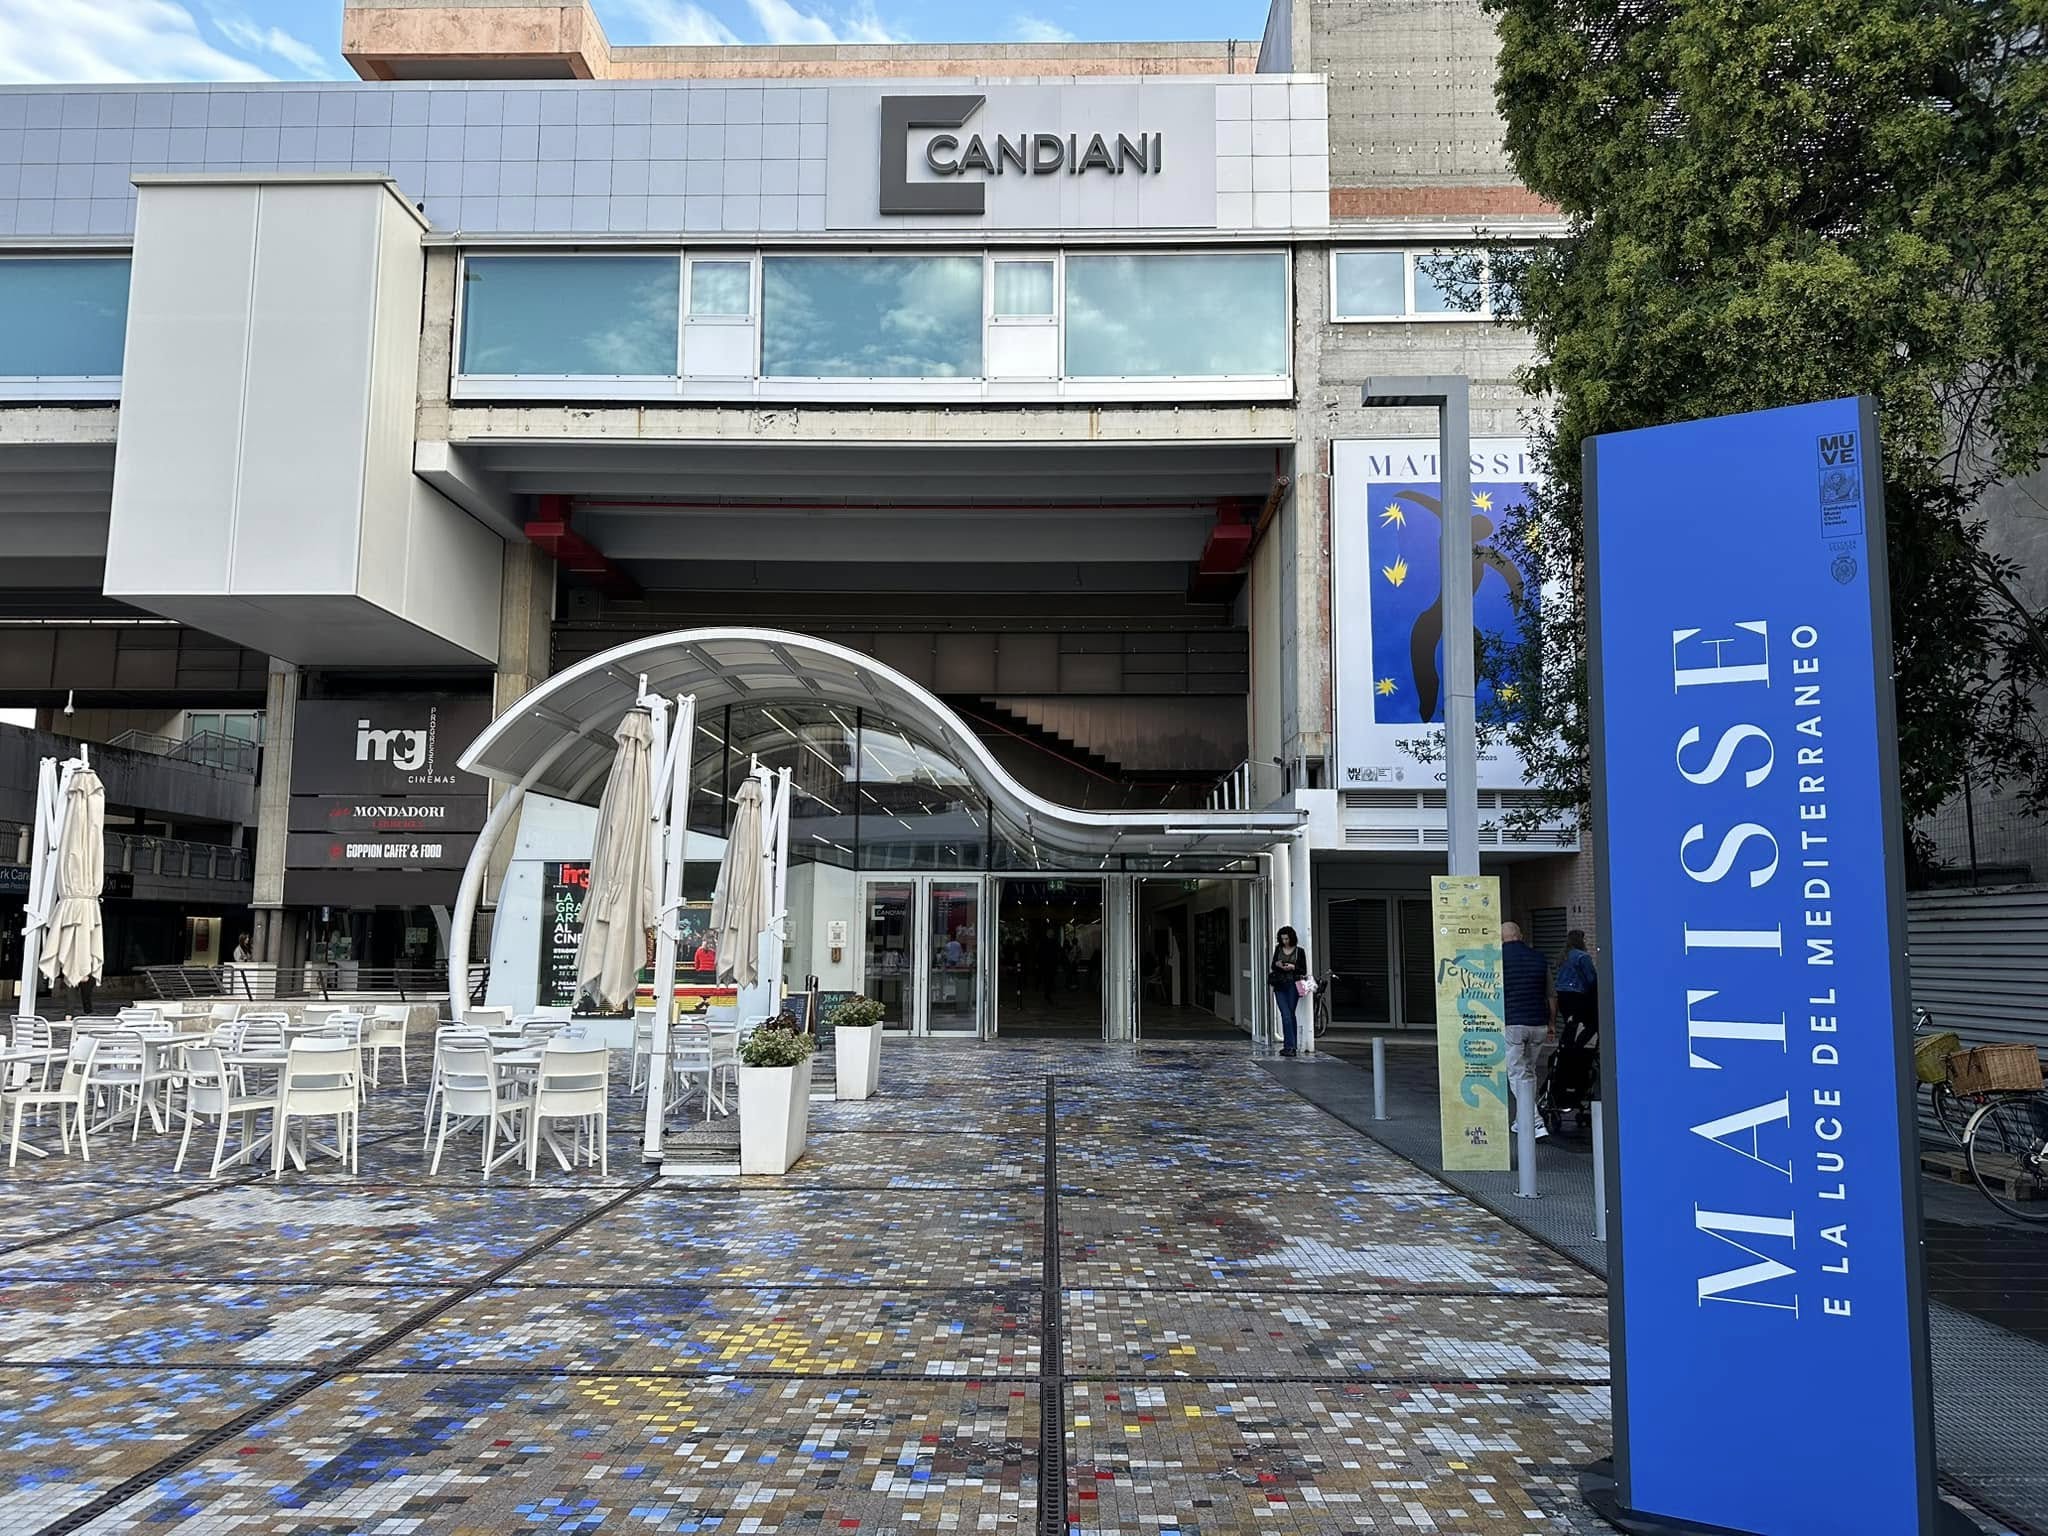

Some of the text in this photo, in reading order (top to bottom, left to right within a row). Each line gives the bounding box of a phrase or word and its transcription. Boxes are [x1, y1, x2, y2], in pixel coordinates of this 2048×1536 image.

[926, 132, 1162, 175] CANDIANI
[1368, 454, 1534, 477] MATSS
[408, 775, 456, 784] CINEMAS
[352, 806, 445, 817] MONDADORI
[346, 844, 382, 858] GOPPION
[411, 845, 419, 858] &
[420, 844, 442, 858] FOOD
[556, 892, 573, 902] LA
[554, 922, 572, 933] AL
[1461, 967, 1501, 979] Premio
[1672, 620, 1798, 1320] MATISSE
[1791, 624, 1851, 1316] E LA LUCE DEL MEDITERRANEO
